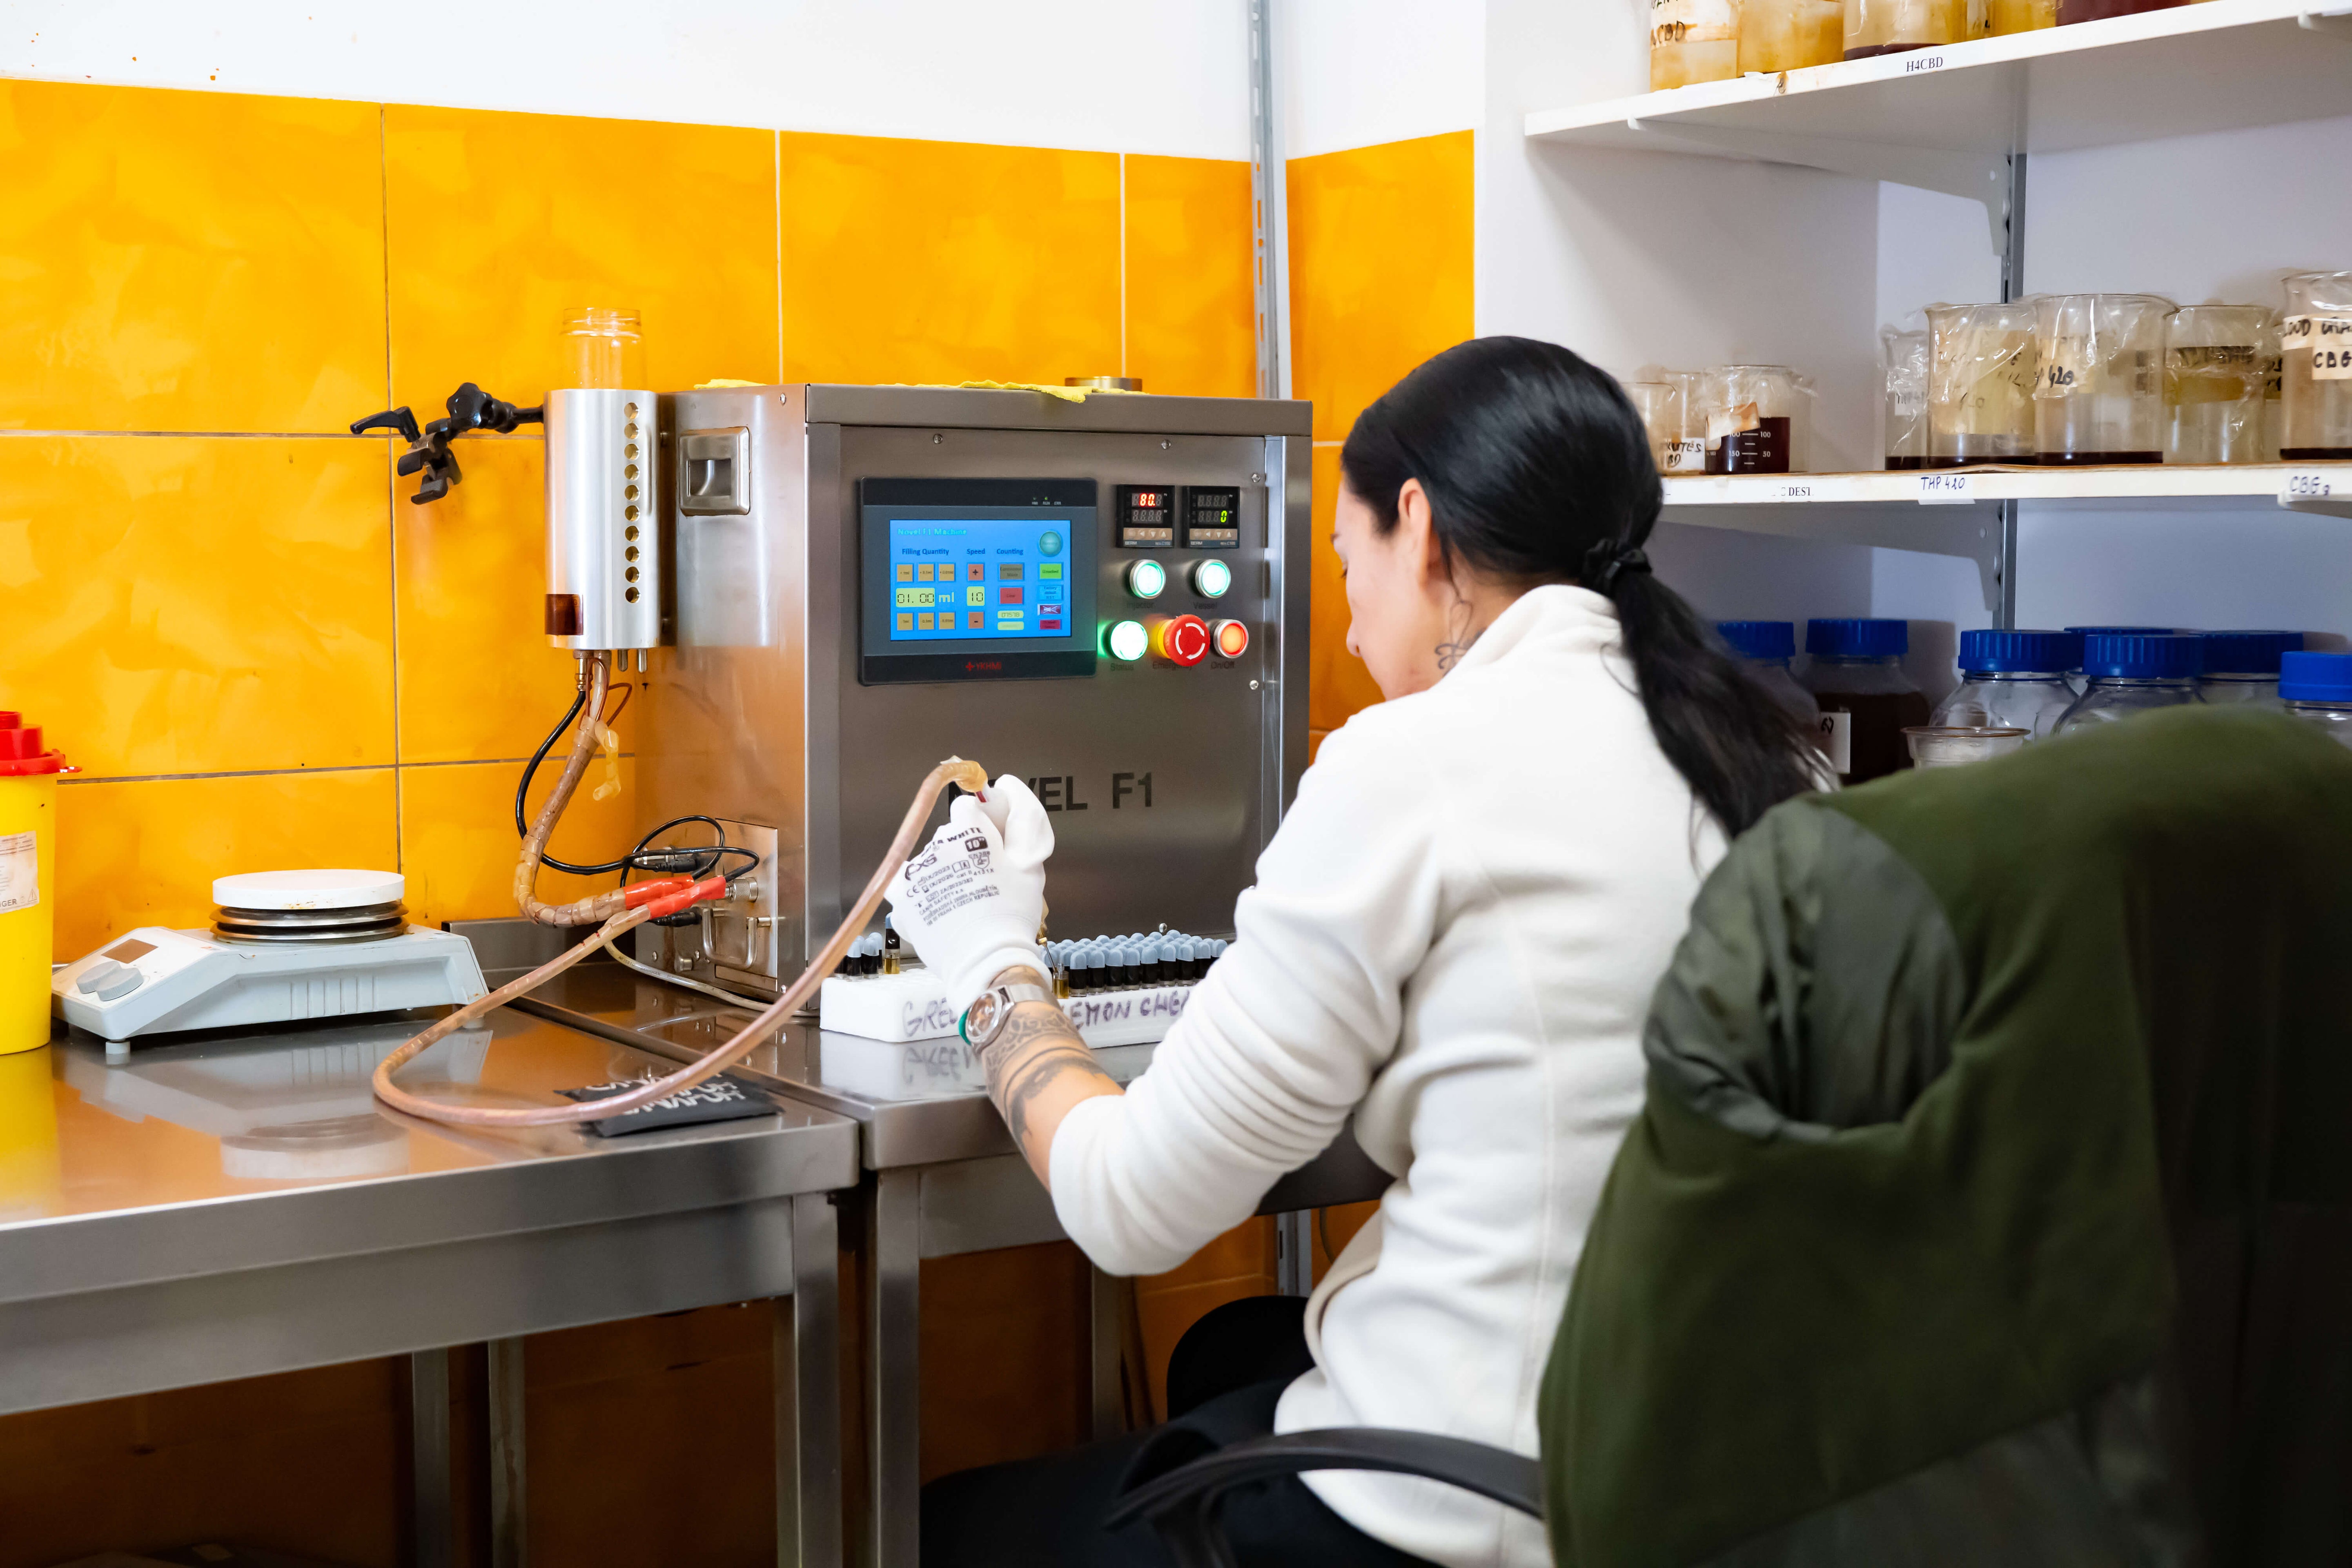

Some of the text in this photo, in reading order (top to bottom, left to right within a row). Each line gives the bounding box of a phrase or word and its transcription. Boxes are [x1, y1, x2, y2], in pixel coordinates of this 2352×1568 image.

[1907, 57, 1943, 72] H4CBD
[1921, 476, 1941, 490] THP
[939, 592, 955, 603] ml
[971, 592, 984, 602] 10
[1127, 601, 1154, 610] Injector
[1193, 601, 1218, 610] Vessel
[1110, 663, 1134, 671] Status
[1152, 661, 1192, 670] Emergey
[1211, 661, 1234, 670] On/Off
[1112, 772, 1152, 809] F1
[0, 899, 17, 907] GER
[1061, 999, 1132, 1030] EMON
